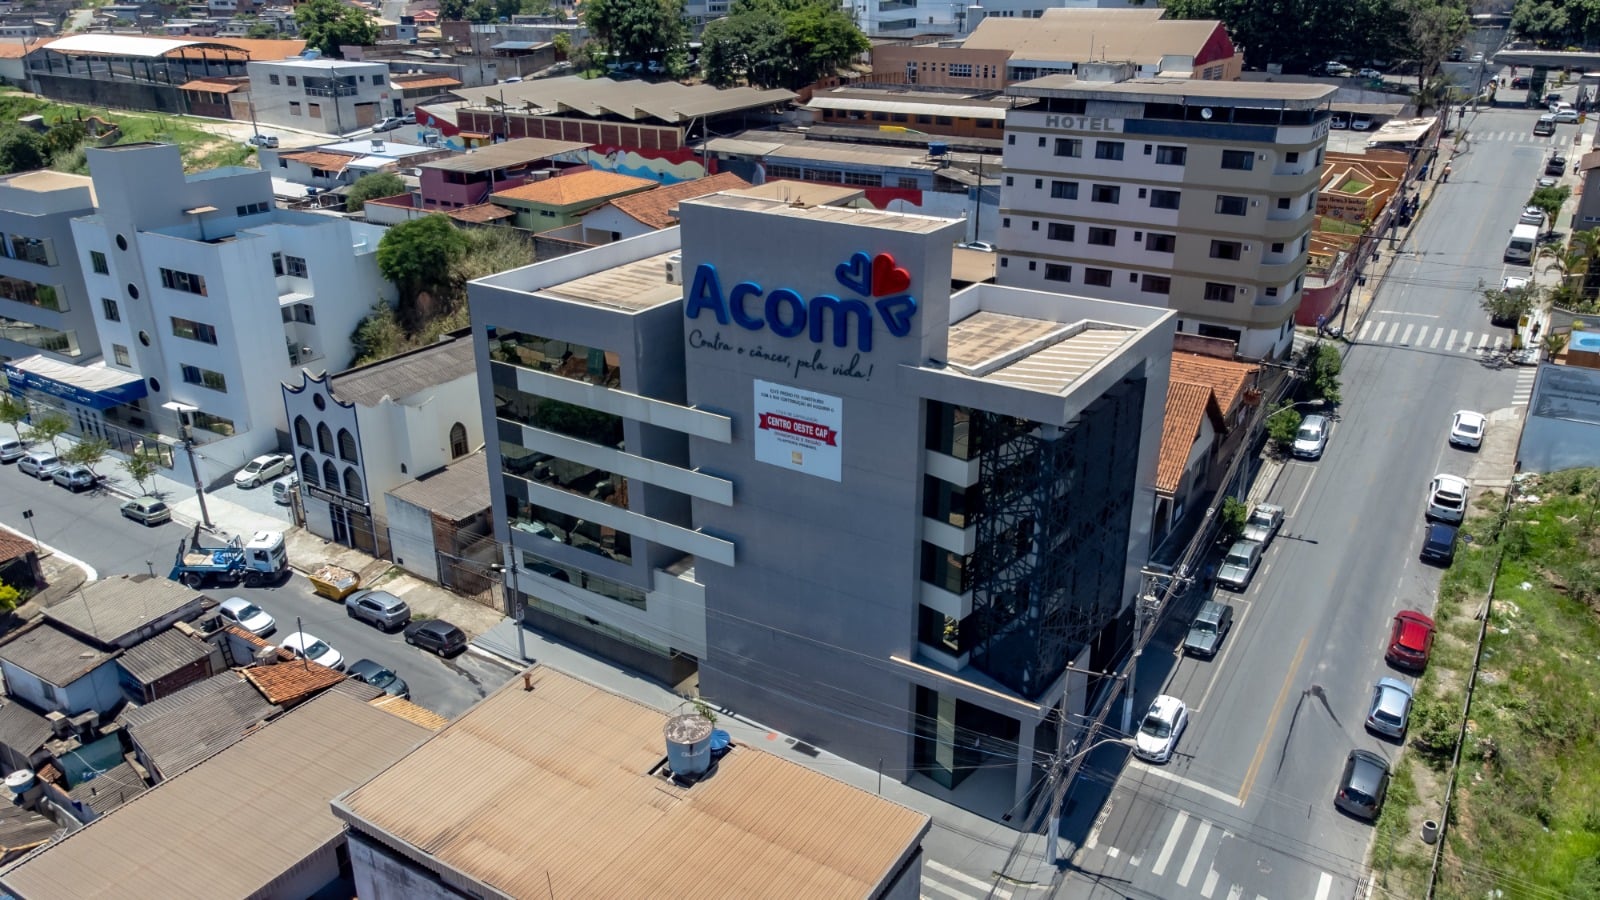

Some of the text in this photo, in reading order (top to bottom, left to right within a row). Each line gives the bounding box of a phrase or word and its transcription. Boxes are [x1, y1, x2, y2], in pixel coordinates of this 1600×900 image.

[1045, 115, 1114, 131] HOTEL
[686, 262, 873, 352] Acom
[689, 328, 874, 381] Contra o câncer, pela vida!
[767, 416, 792, 430] CENTRO
[793, 422, 814, 436] OESTE
[815, 427, 829, 438] CAP
